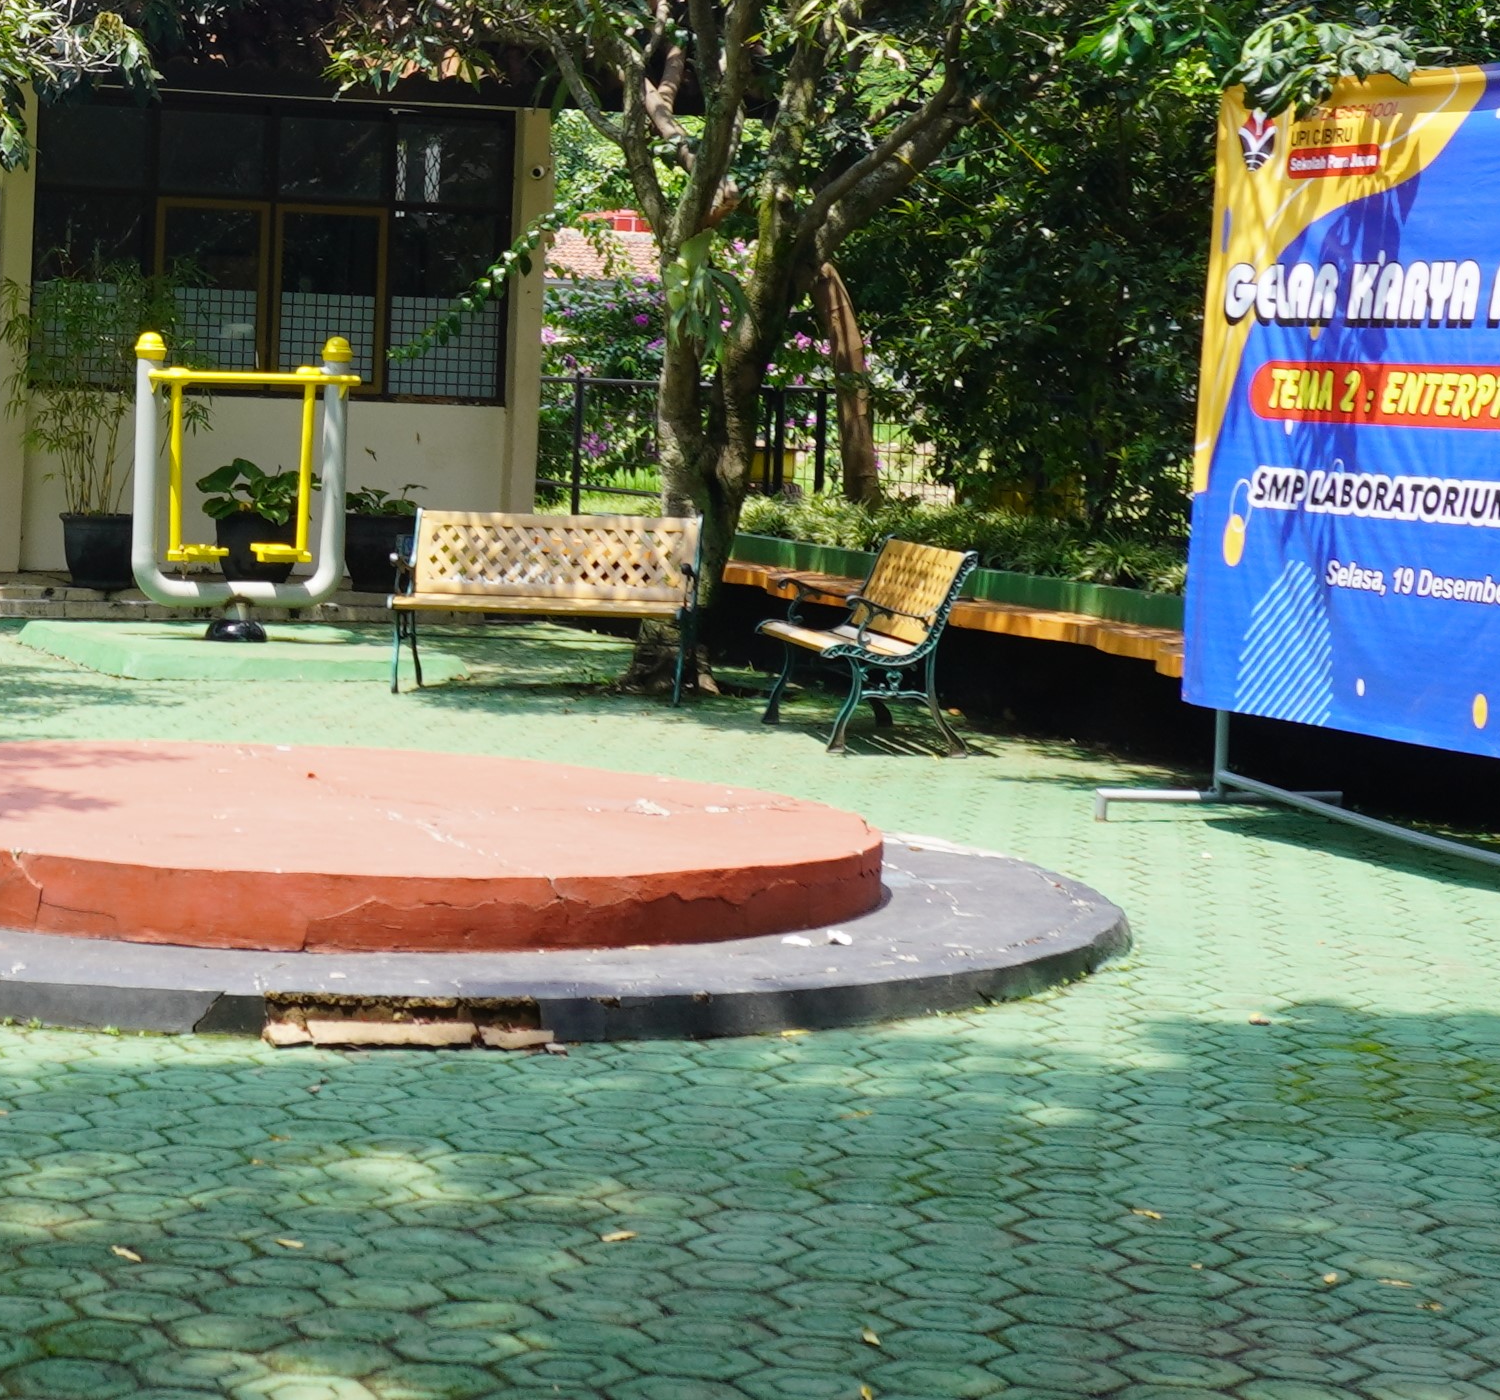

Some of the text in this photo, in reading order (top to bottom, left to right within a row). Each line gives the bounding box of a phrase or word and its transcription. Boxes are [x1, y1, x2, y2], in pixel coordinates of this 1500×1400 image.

[1291, 127, 1353, 146] UPI CIBIRU
[1289, 156, 1327, 171] Sekolah
[1225, 262, 1339, 326] GELAR
[1344, 258, 1481, 328] KARYA
[1268, 368, 1335, 411] TEMA
[1339, 369, 1362, 414] 2
[1251, 468, 1307, 508] SMP
[1325, 559, 1387, 597] Selasa,
[1392, 566, 1415, 595] 19
